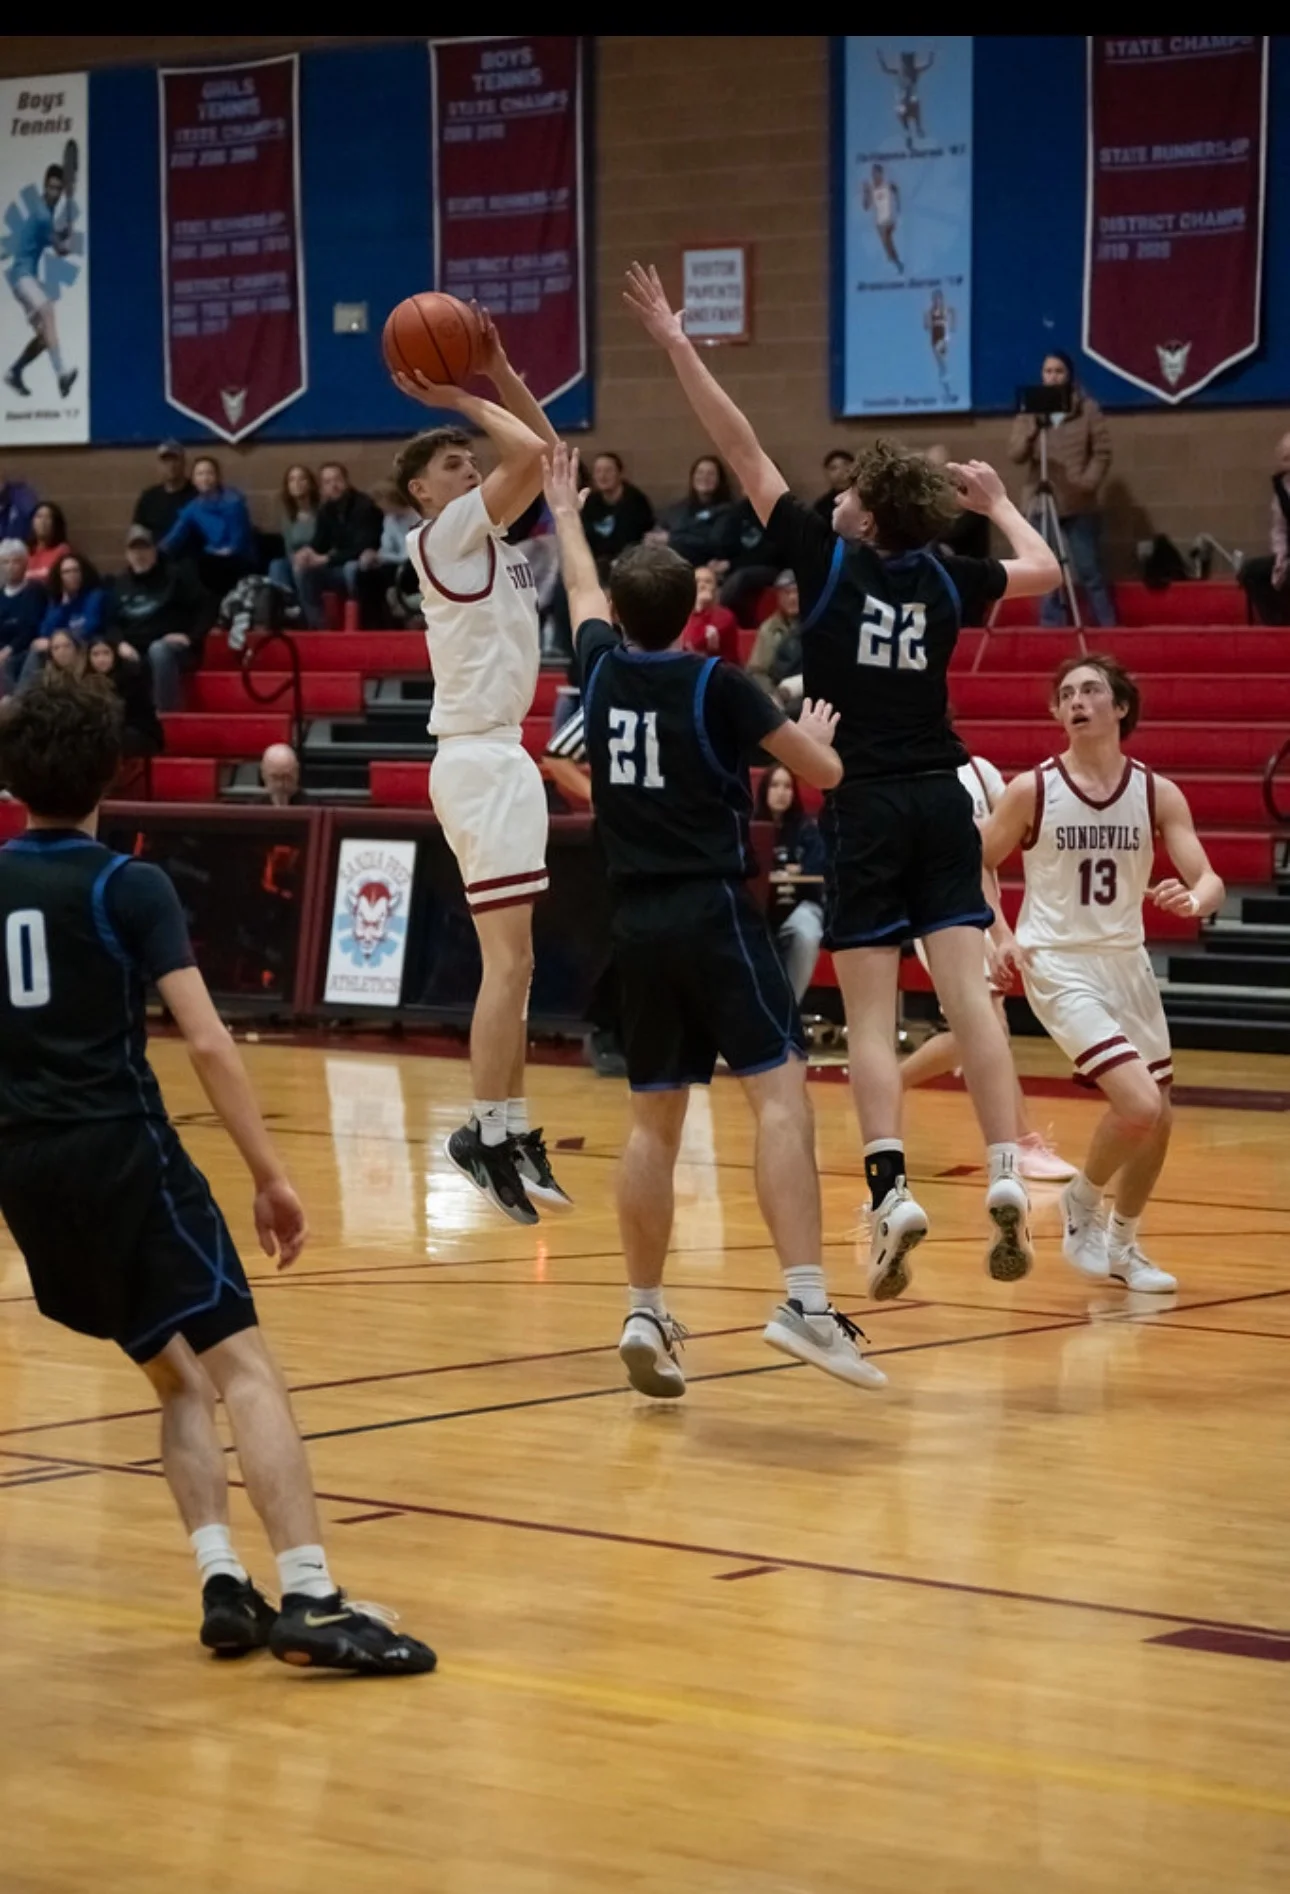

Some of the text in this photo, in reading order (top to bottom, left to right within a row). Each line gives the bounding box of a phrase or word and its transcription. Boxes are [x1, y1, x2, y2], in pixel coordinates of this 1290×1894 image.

[481, 46, 532, 70] BOYS
[1105, 40, 1163, 57] STATE
[202, 77, 255, 99] GIRLS
[472, 67, 542, 92] TENNIS
[17, 91, 65, 114] Boys
[197, 97, 261, 121] TENNIS
[10, 115, 73, 136] Tennis
[1099, 147, 1147, 164] STATE
[1099, 207, 1246, 234] DISTRICT CHAMPS
[857, 594, 928, 671] 22
[608, 707, 666, 788] 21
[1055, 825, 1140, 851] SUNDEVILS
[1078, 858, 1117, 906] 13
[6, 909, 51, 1008] 0
